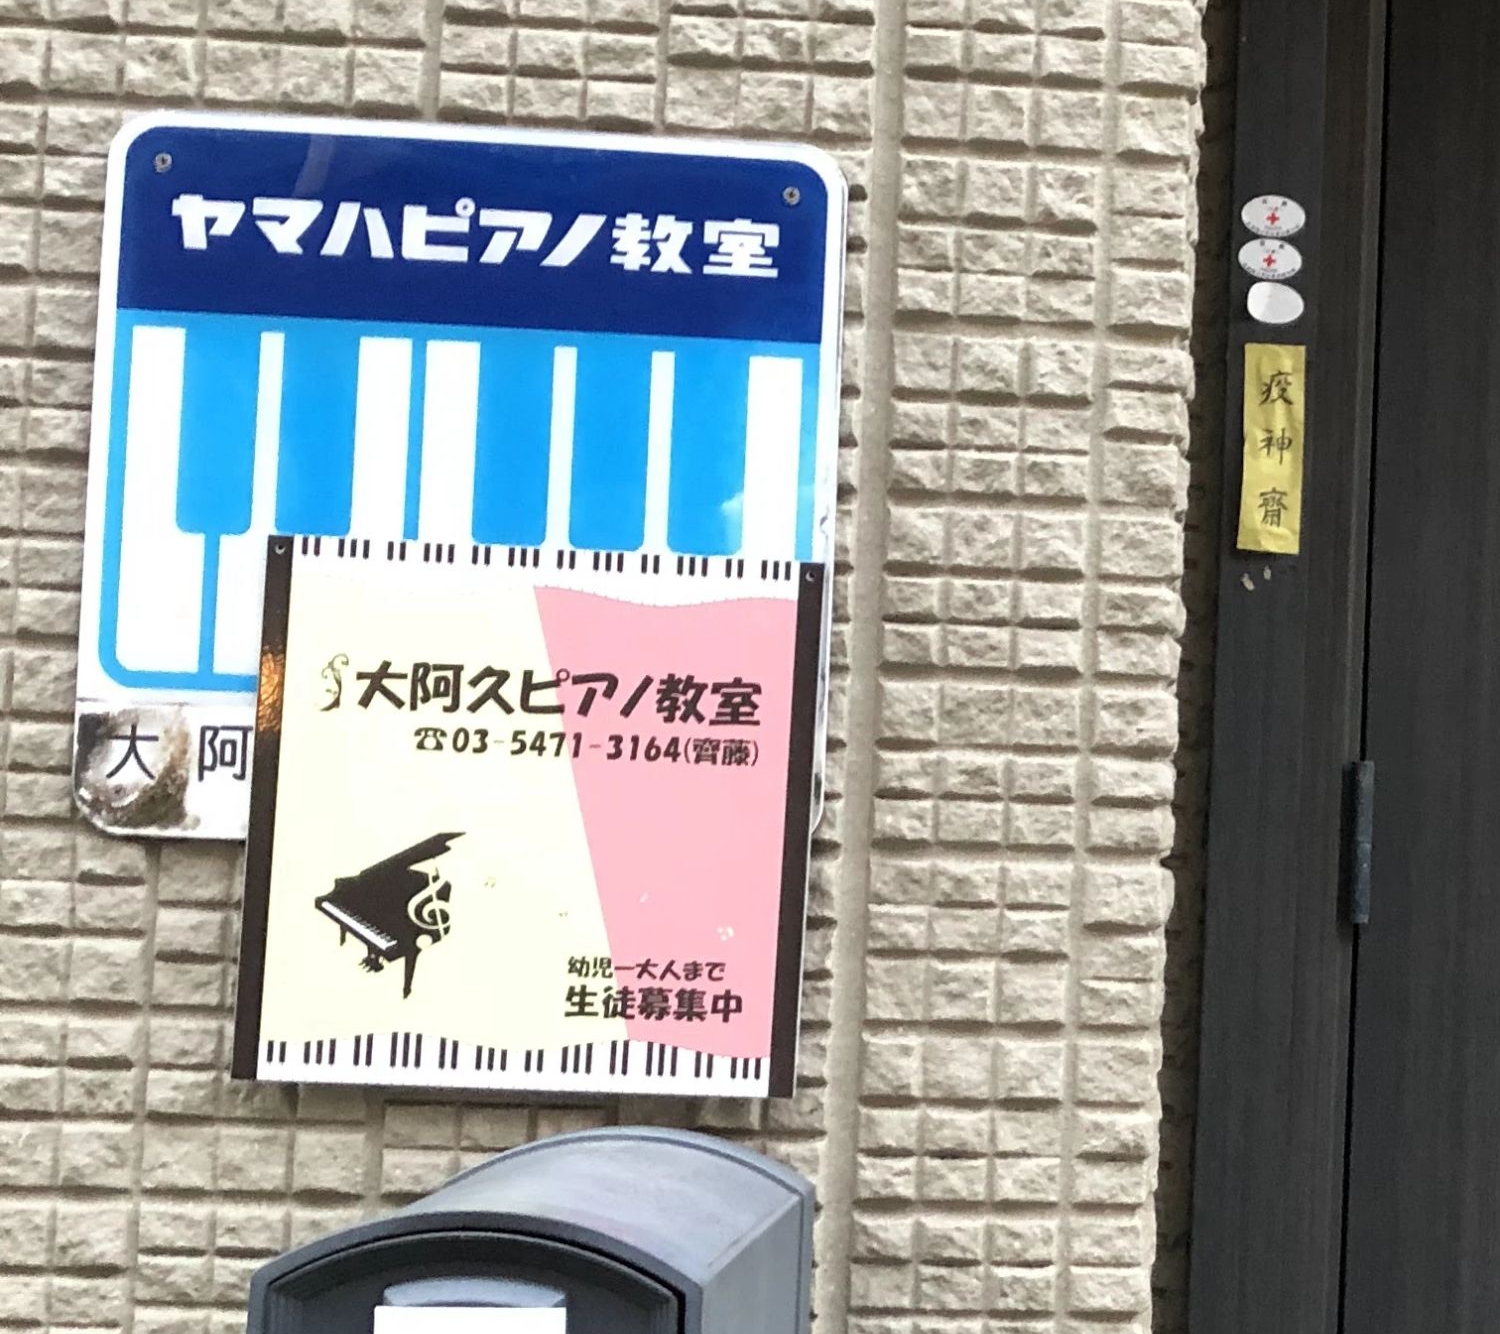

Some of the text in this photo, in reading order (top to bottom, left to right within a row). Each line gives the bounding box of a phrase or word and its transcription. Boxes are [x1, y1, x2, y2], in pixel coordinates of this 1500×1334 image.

[171, 192, 782, 279] ヤマハピアノ教室
[355, 659, 763, 727] 大阿久ピアノ教室
[563, 984, 743, 1024] 生徒募集中
